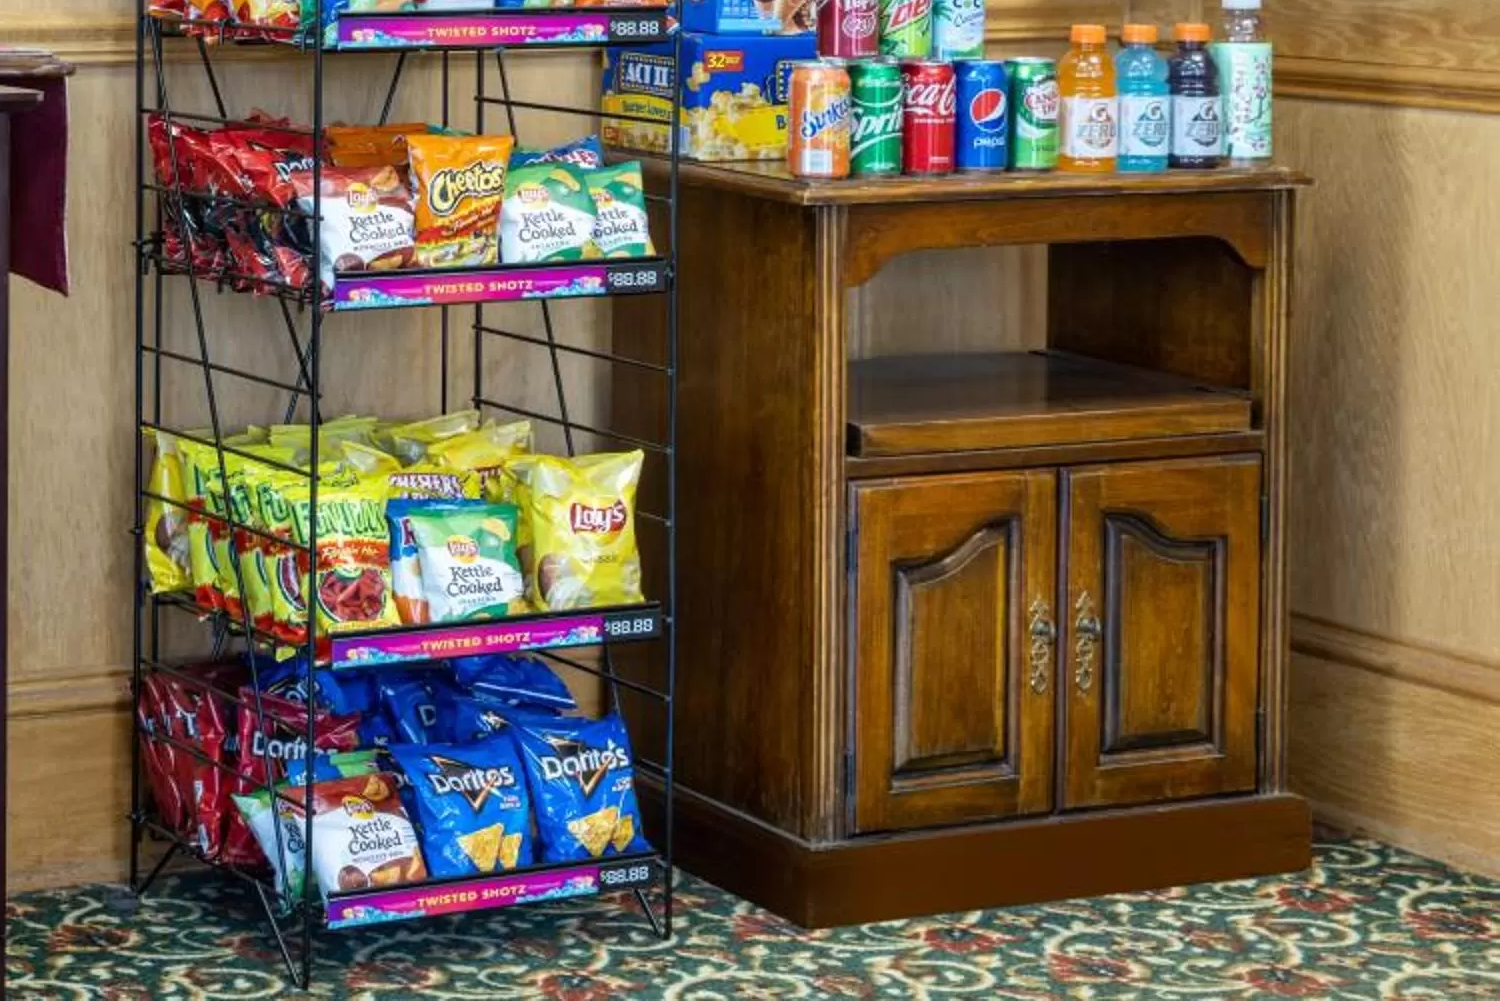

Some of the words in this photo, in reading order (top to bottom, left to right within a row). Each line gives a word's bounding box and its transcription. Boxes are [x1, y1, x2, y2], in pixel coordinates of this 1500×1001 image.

[427, 26, 487, 39] TWISTED
[490, 25, 537, 38] SHOTZ
[610, 20, 660, 37] $88.88
[707, 52, 726, 69] 32
[624, 62, 652, 85] ACT
[427, 159, 505, 216] Cheetos
[348, 211, 395, 232] Kettle
[522, 208, 565, 228] Kettle
[595, 207, 629, 223] ettle
[349, 223, 406, 244] Cooked
[518, 222, 577, 243] Cooked
[592, 218, 639, 238] ooked
[423, 282, 485, 295] TWISTED
[489, 279, 533, 292] SHOTZ
[570, 498, 627, 534] Lay's
[449, 564, 494, 583] Kettle
[446, 576, 504, 598] Cooked
[604, 617, 654, 636] $88.88
[420, 634, 483, 652] TWISTED
[485, 630, 532, 647] SHOTZ
[540, 745, 630, 781] Doritos
[428, 765, 515, 795] Doritos
[348, 817, 392, 843] Kettle
[348, 834, 403, 858] Cooked
[416, 891, 478, 908] TWISTED
[481, 884, 528, 899] SHOTZ
